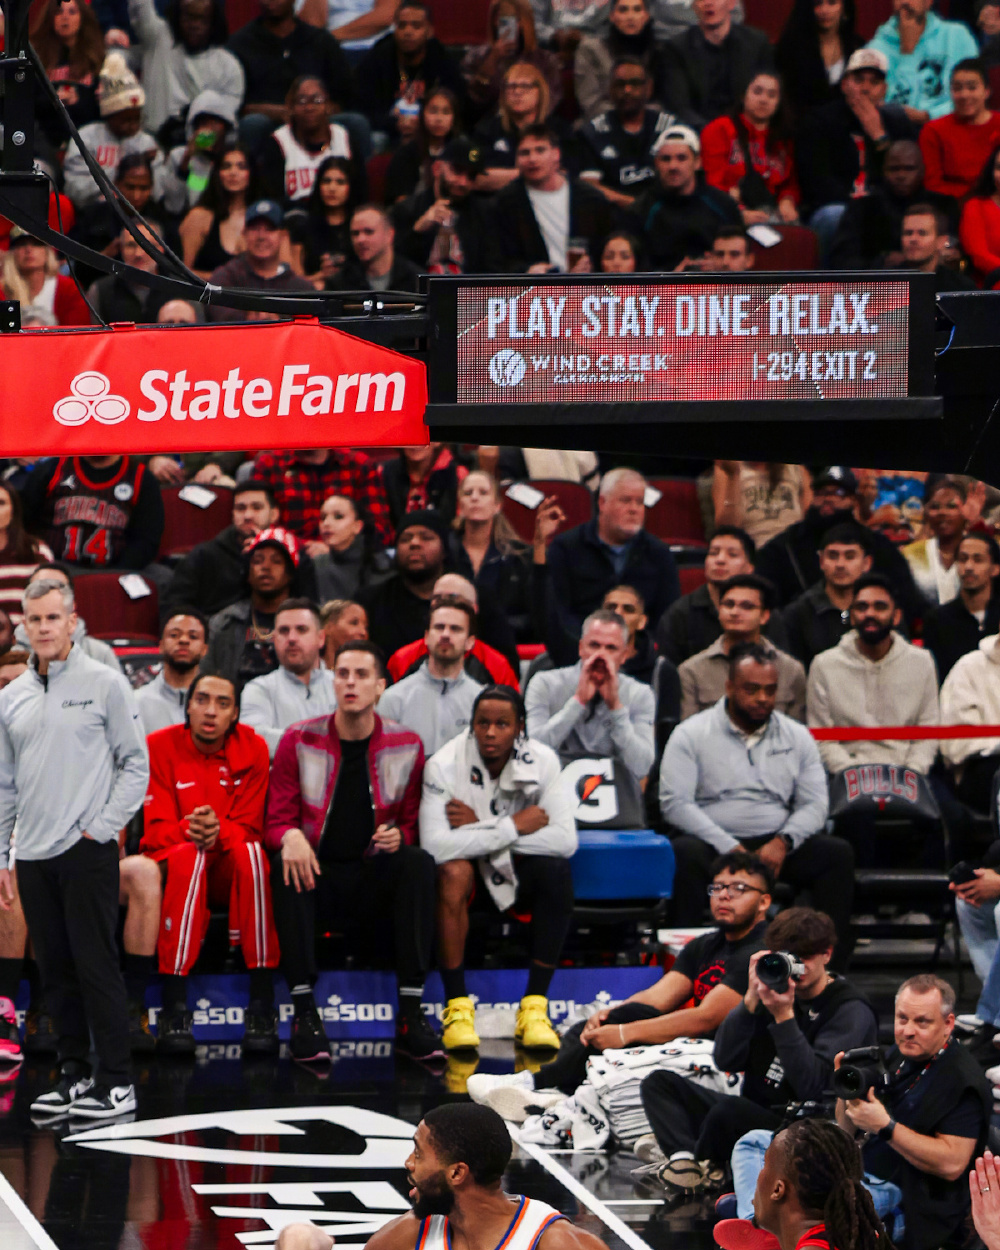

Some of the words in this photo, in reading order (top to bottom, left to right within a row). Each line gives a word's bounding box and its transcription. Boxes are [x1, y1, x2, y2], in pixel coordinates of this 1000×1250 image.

[487, 296, 571, 338] PLAY.
[581, 295, 664, 337] STAY.
[675, 293, 759, 336] DINE.
[769, 292, 878, 335] RELAX.
[531, 355, 592, 373] WIND
[595, 353, 668, 372] CREEK
[811, 351, 859, 381] EXIT
[864, 350, 876, 380] 2
[137, 367, 273, 421] State
[277, 364, 406, 417] Farm
[62, 525, 111, 565] 14
[62, 699, 93, 710] Chicago
[845, 765, 918, 803] BULLS
[279, 1003, 392, 1023] Ps500
